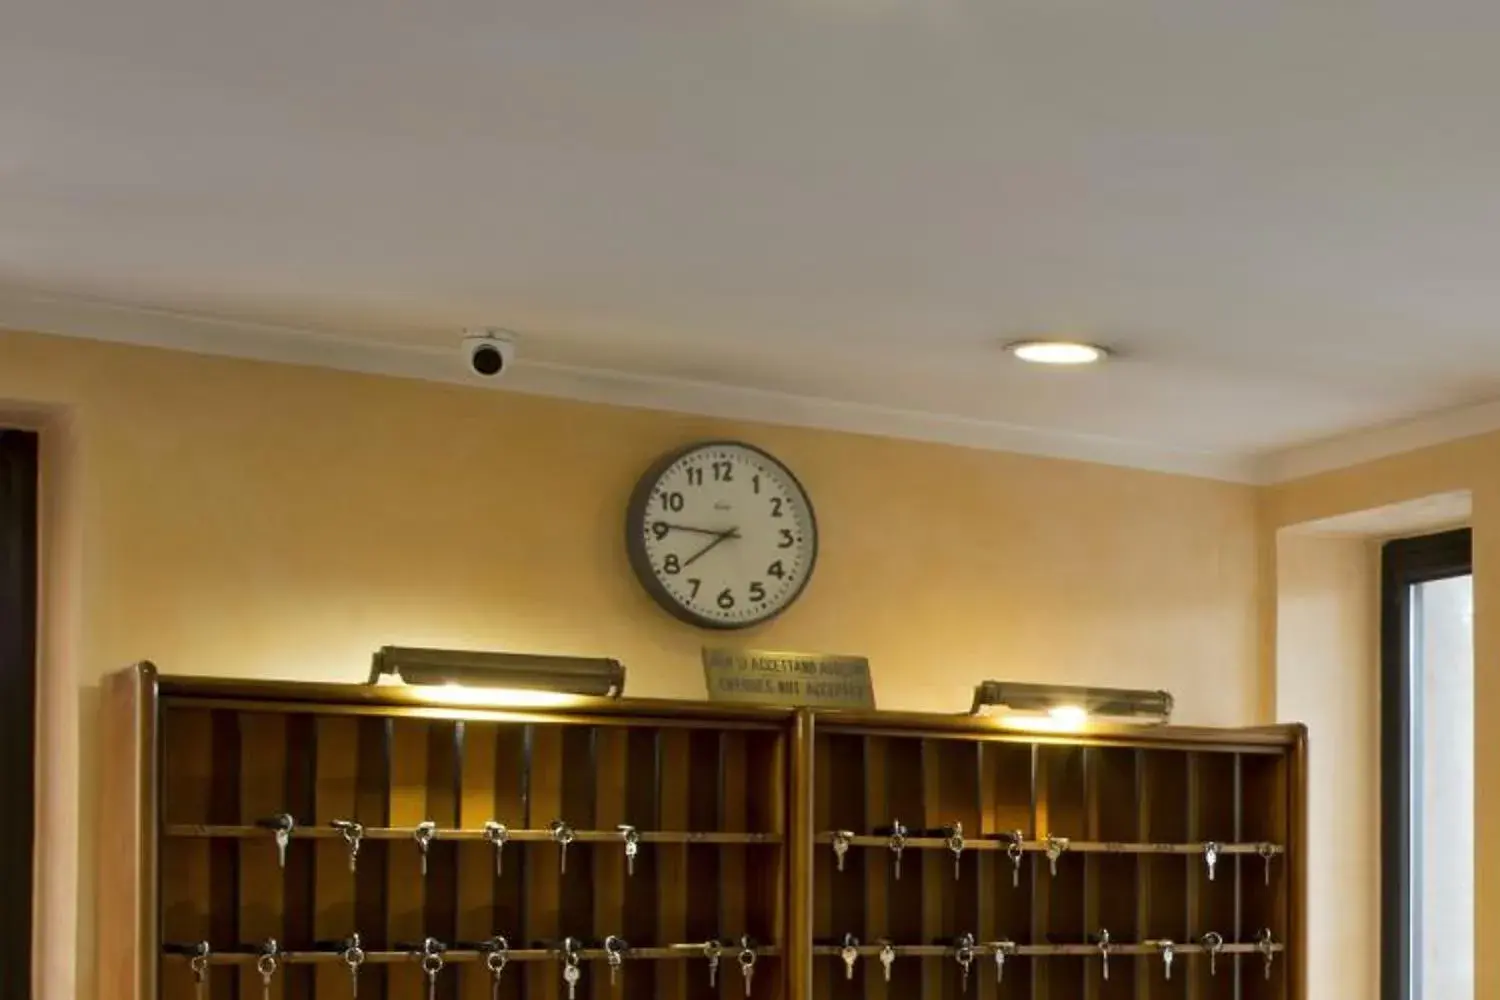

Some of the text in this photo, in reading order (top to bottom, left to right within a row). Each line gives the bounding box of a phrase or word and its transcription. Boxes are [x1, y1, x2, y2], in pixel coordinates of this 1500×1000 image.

[687, 467, 703, 486] 11
[712, 461, 734, 482] 12
[752, 474, 760, 495] 1
[660, 492, 684, 512] 10
[770, 497, 783, 518] 2
[652, 521, 669, 540] 9
[778, 529, 794, 548] 3
[663, 554, 681, 575] 8
[767, 561, 785, 580] 4
[687, 579, 701, 598] 7
[750, 582, 766, 602] 5
[717, 589, 735, 609] 6
